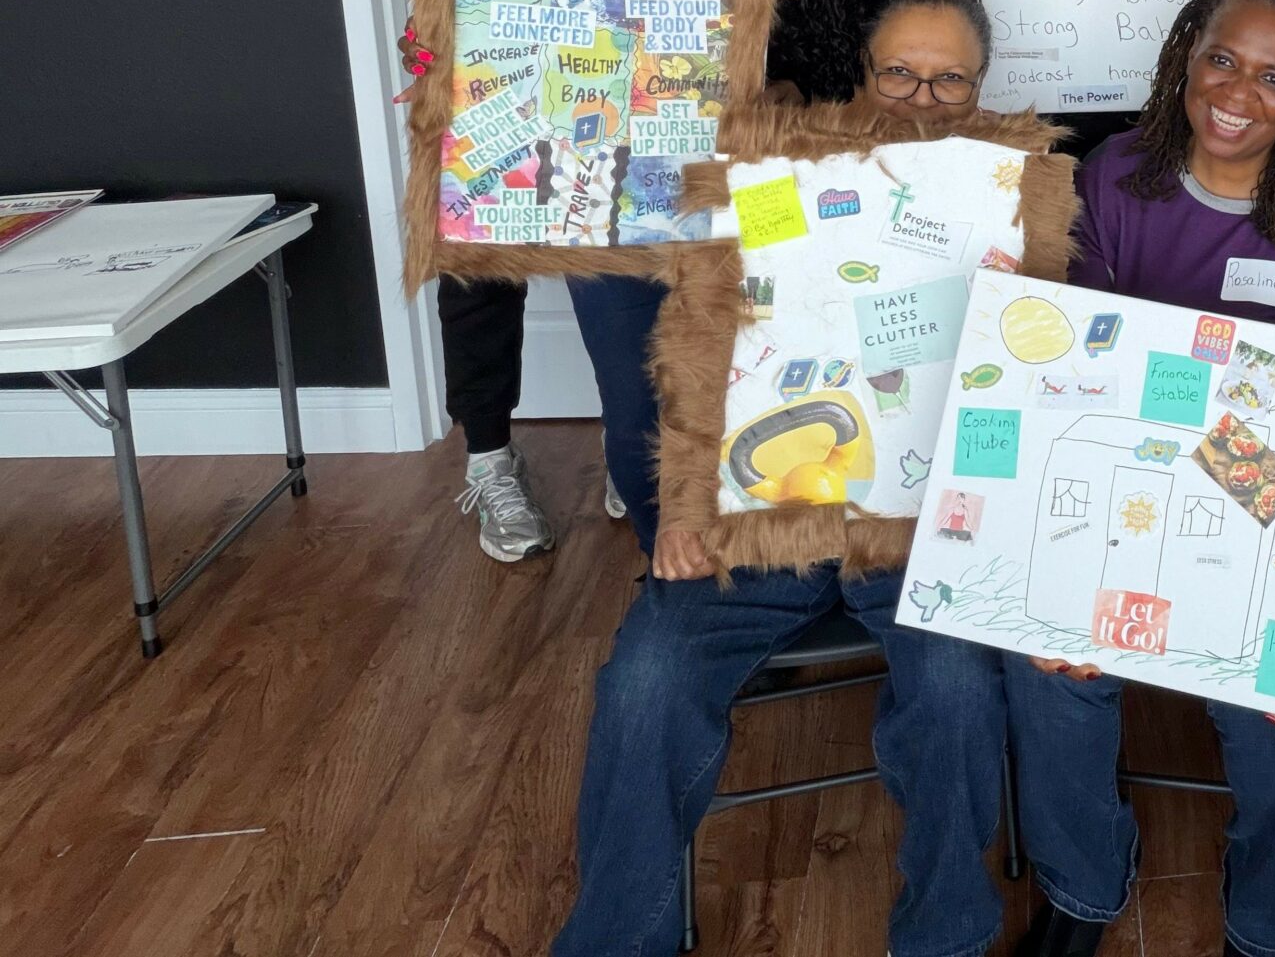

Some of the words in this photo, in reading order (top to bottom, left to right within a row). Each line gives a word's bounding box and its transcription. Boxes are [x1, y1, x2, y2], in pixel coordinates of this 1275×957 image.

[497, 4, 540, 23] FEEL
[540, 8, 589, 28] MORE
[629, 0, 670, 17] FEED
[490, 22, 594, 46] CONNECTED
[652, 17, 698, 33] BODY
[993, 9, 1079, 48] Strong
[644, 36, 659, 51] &
[661, 35, 705, 51] SOUL
[464, 44, 539, 67] INCREASE
[558, 53, 623, 75] HEALTHY
[469, 64, 535, 96] REVENUE
[562, 84, 610, 108] BABY
[1062, 93, 1084, 104] The
[1087, 91, 1125, 103] Power
[452, 90, 518, 138] BECOME
[661, 103, 690, 119] SET
[471, 110, 521, 150] MORE
[635, 119, 717, 137] YOURSELF
[465, 116, 546, 171] RESILIENT
[502, 189, 535, 207] PUT
[563, 158, 595, 235] TRAVEL
[820, 190, 857, 205] Have
[475, 206, 563, 225] YOURSELF
[821, 201, 859, 218] FAITH
[493, 224, 544, 242] FIRST
[903, 212, 947, 232] Project
[892, 223, 950, 246] Declutter
[874, 292, 918, 311] HAVE
[880, 309, 918, 327] LESS
[1200, 319, 1232, 339] GOD
[864, 322, 939, 347] CLUTTER
[1197, 335, 1230, 350] VIBES
[1151, 361, 1202, 384] Financial
[962, 411, 1016, 436] Cooking
[1115, 593, 1156, 624] Let
[1098, 619, 1119, 643] It
[1121, 621, 1164, 655] Go!
